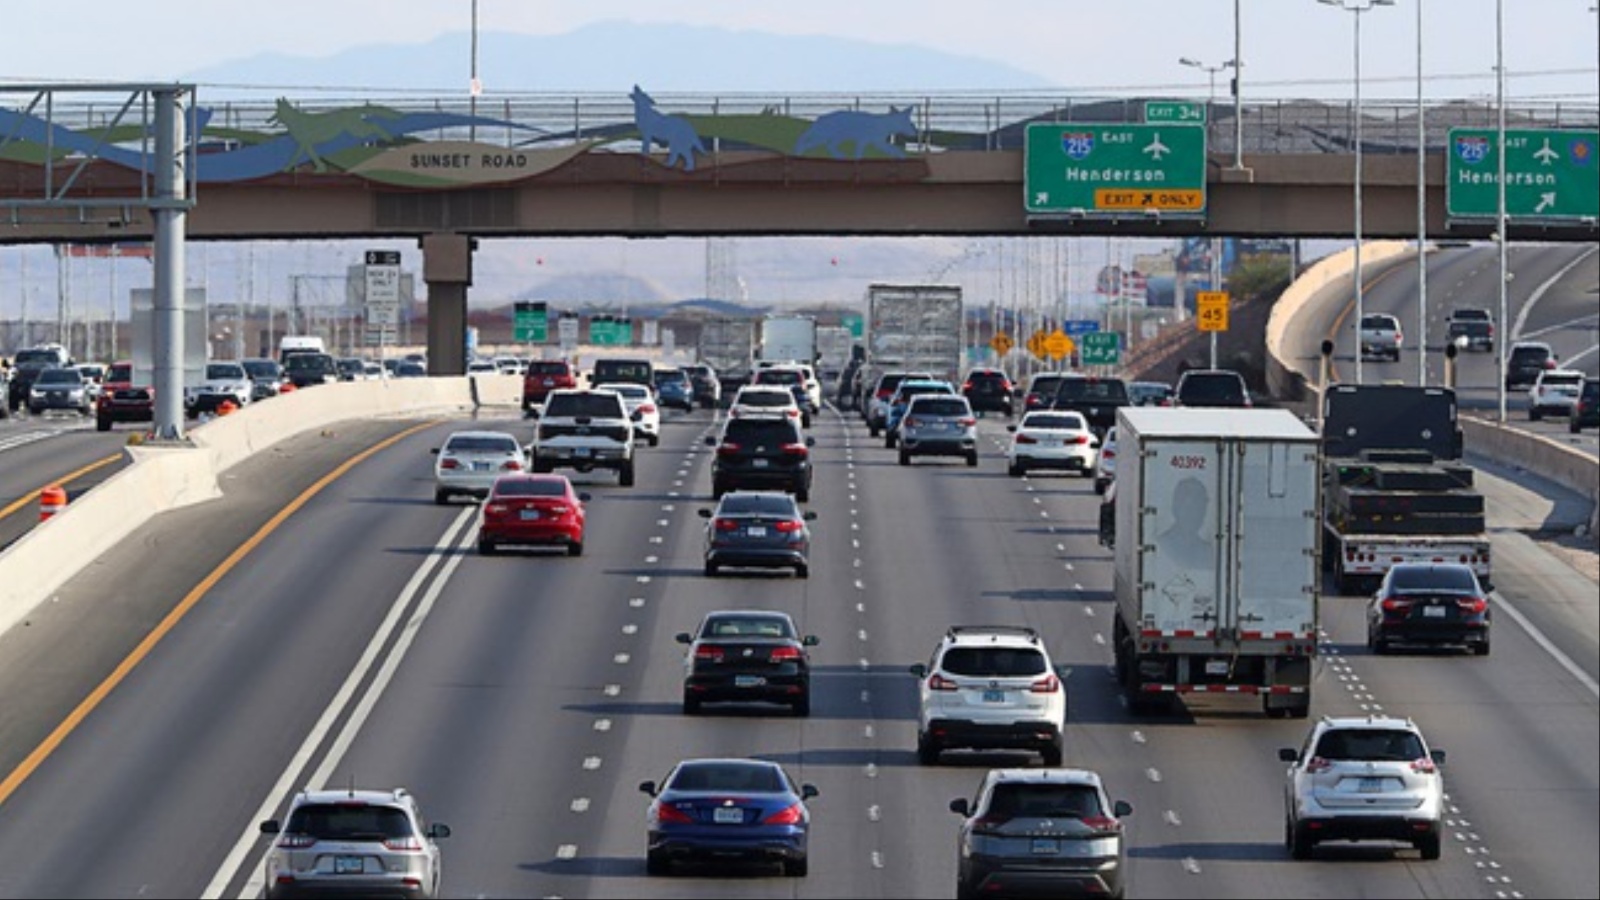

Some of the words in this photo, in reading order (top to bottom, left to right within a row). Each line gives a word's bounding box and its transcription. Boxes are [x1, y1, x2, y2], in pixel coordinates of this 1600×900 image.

[1149, 107, 1173, 117] EXIT
[1178, 106, 1200, 120] 34
[1101, 132, 1134, 143] EAST
[1497, 137, 1528, 148] AST
[1067, 138, 1092, 155] 215
[410, 153, 470, 169] SUNSET
[481, 153, 528, 168] ROAD
[1066, 167, 1165, 182] Henderson
[1104, 193, 1134, 205] EXIT
[1159, 193, 1196, 205] ONLY
[1203, 308, 1223, 321] 45
[1084, 346, 1103, 358] 34
[1170, 455, 1207, 469] 40392
